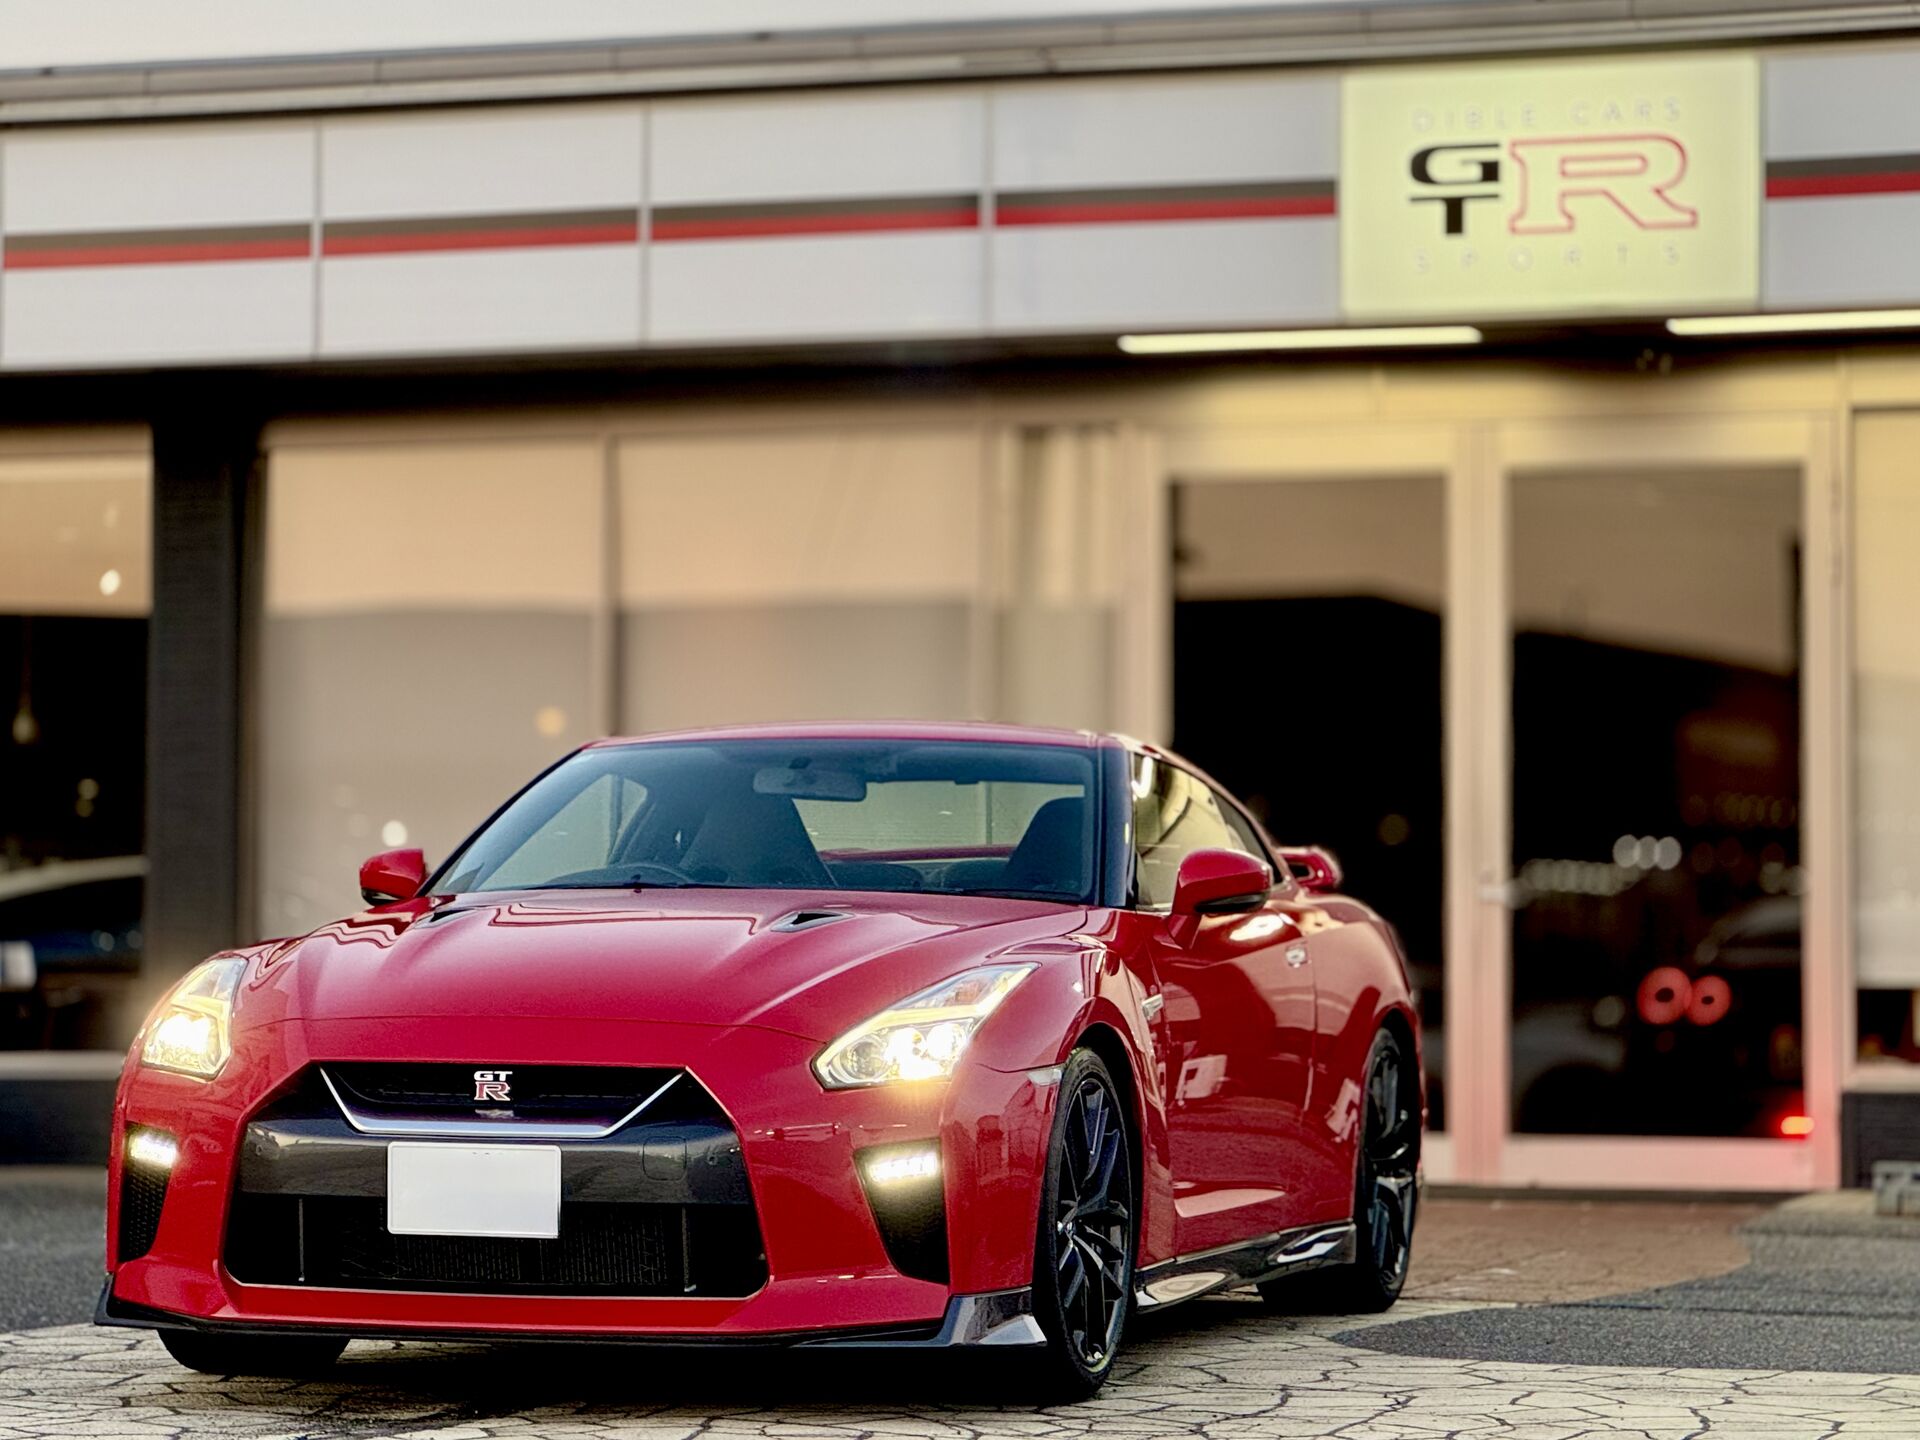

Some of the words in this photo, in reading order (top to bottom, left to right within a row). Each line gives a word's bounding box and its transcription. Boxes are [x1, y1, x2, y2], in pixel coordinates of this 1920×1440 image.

[1568, 96, 1680, 125] CARS
[1412, 239, 1681, 273] SPORTS
[473, 1070, 513, 1082] GT
